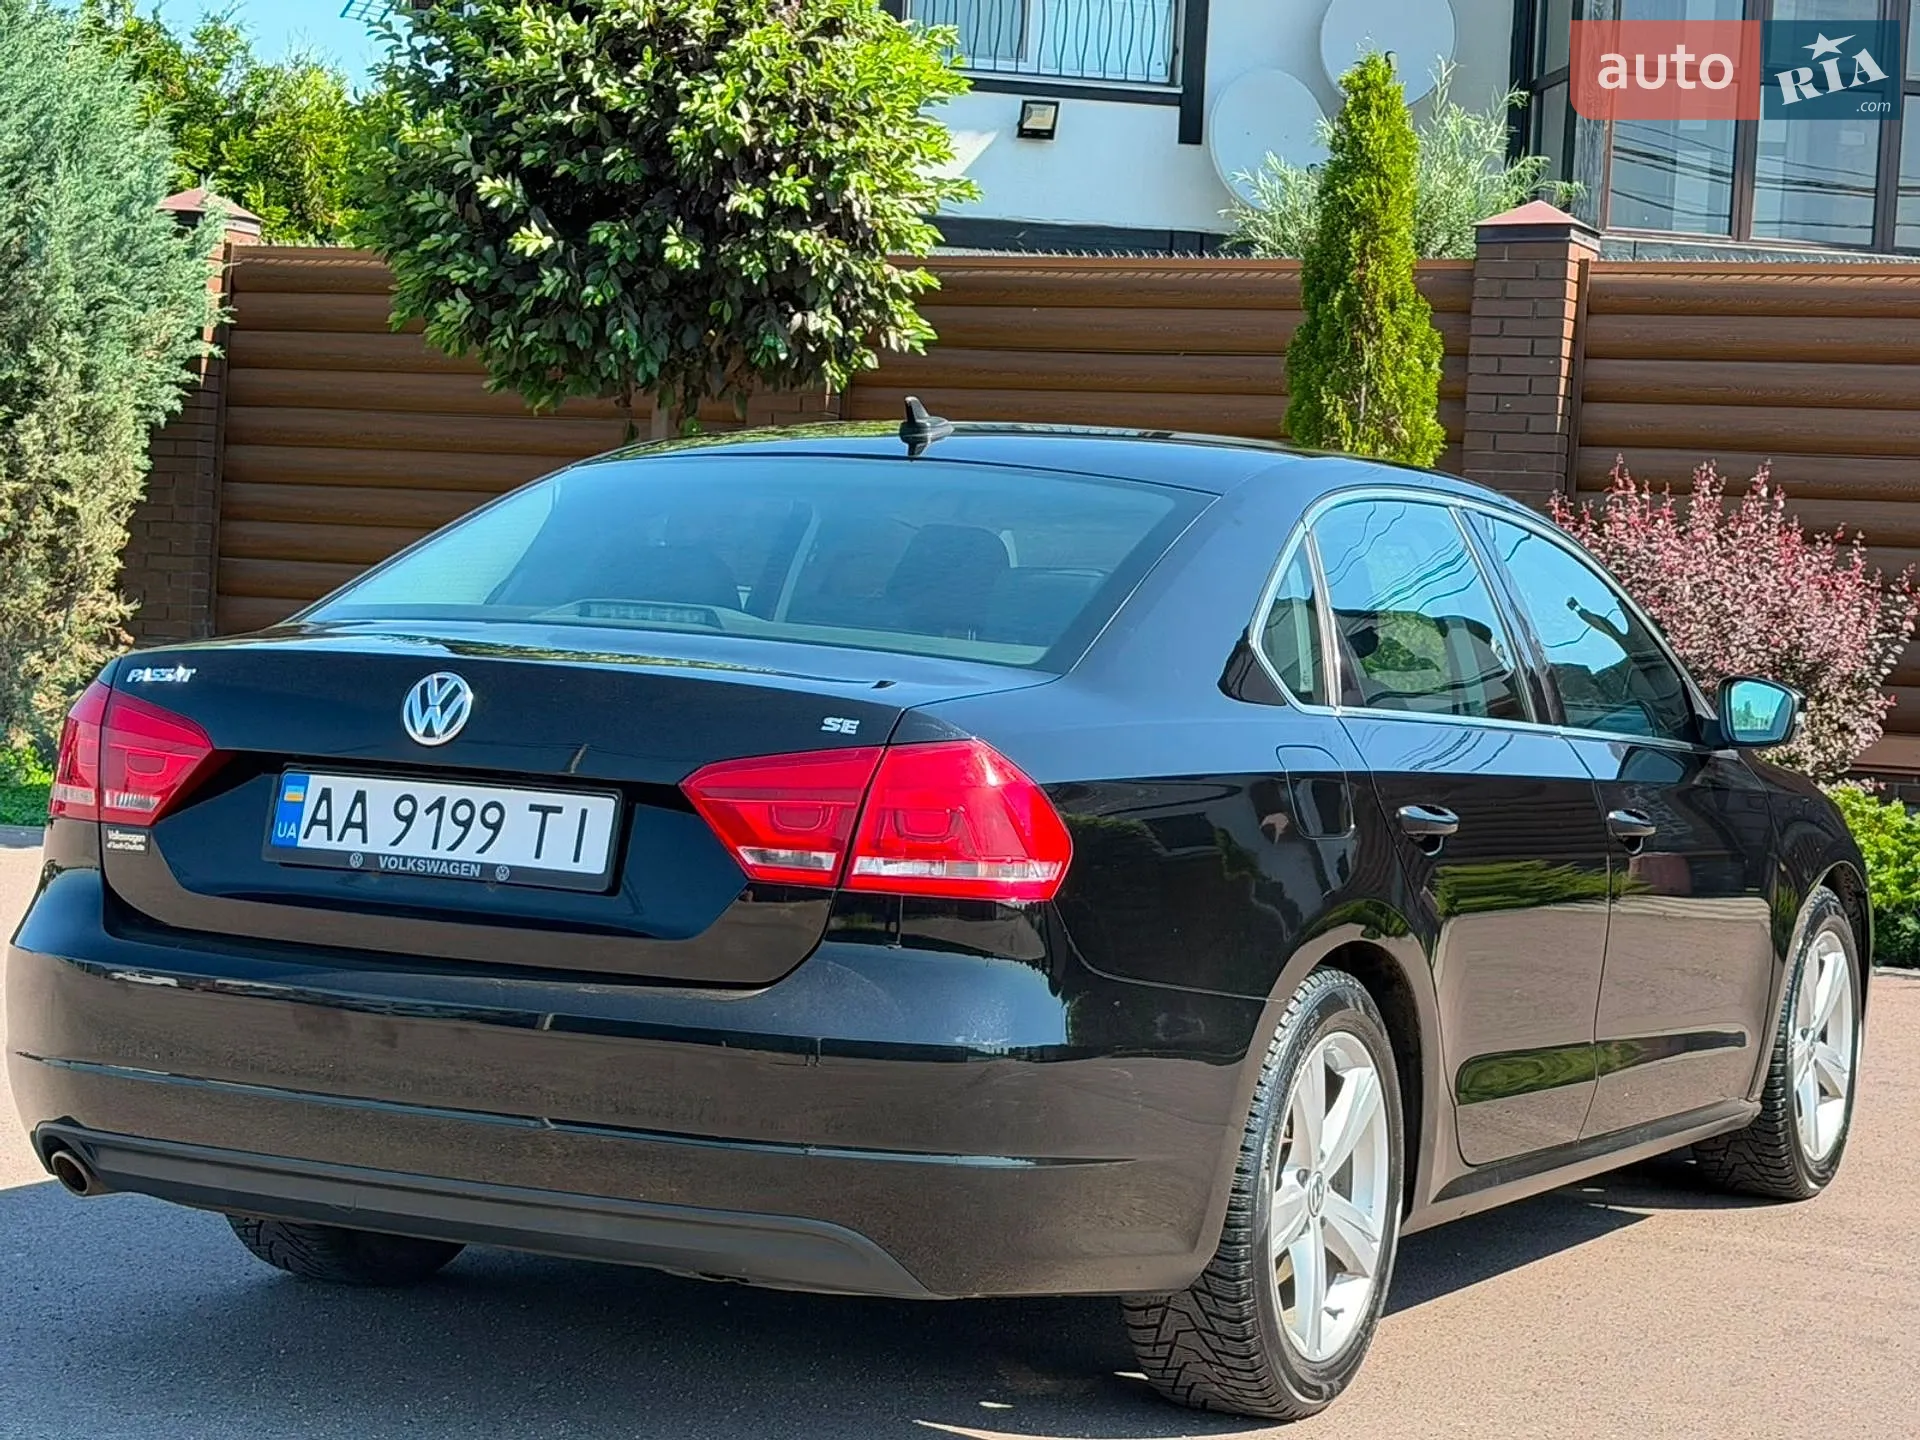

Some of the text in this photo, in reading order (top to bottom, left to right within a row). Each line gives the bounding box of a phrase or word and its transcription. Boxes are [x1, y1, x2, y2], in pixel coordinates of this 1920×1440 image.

[126, 664, 197, 682] PASSAT
[404, 672, 472, 744] VW
[821, 717, 860, 735] SE
[277, 822, 297, 840] UA
[303, 787, 588, 863] AA 9199 TI
[378, 855, 481, 877] VOLKSWAGEN
